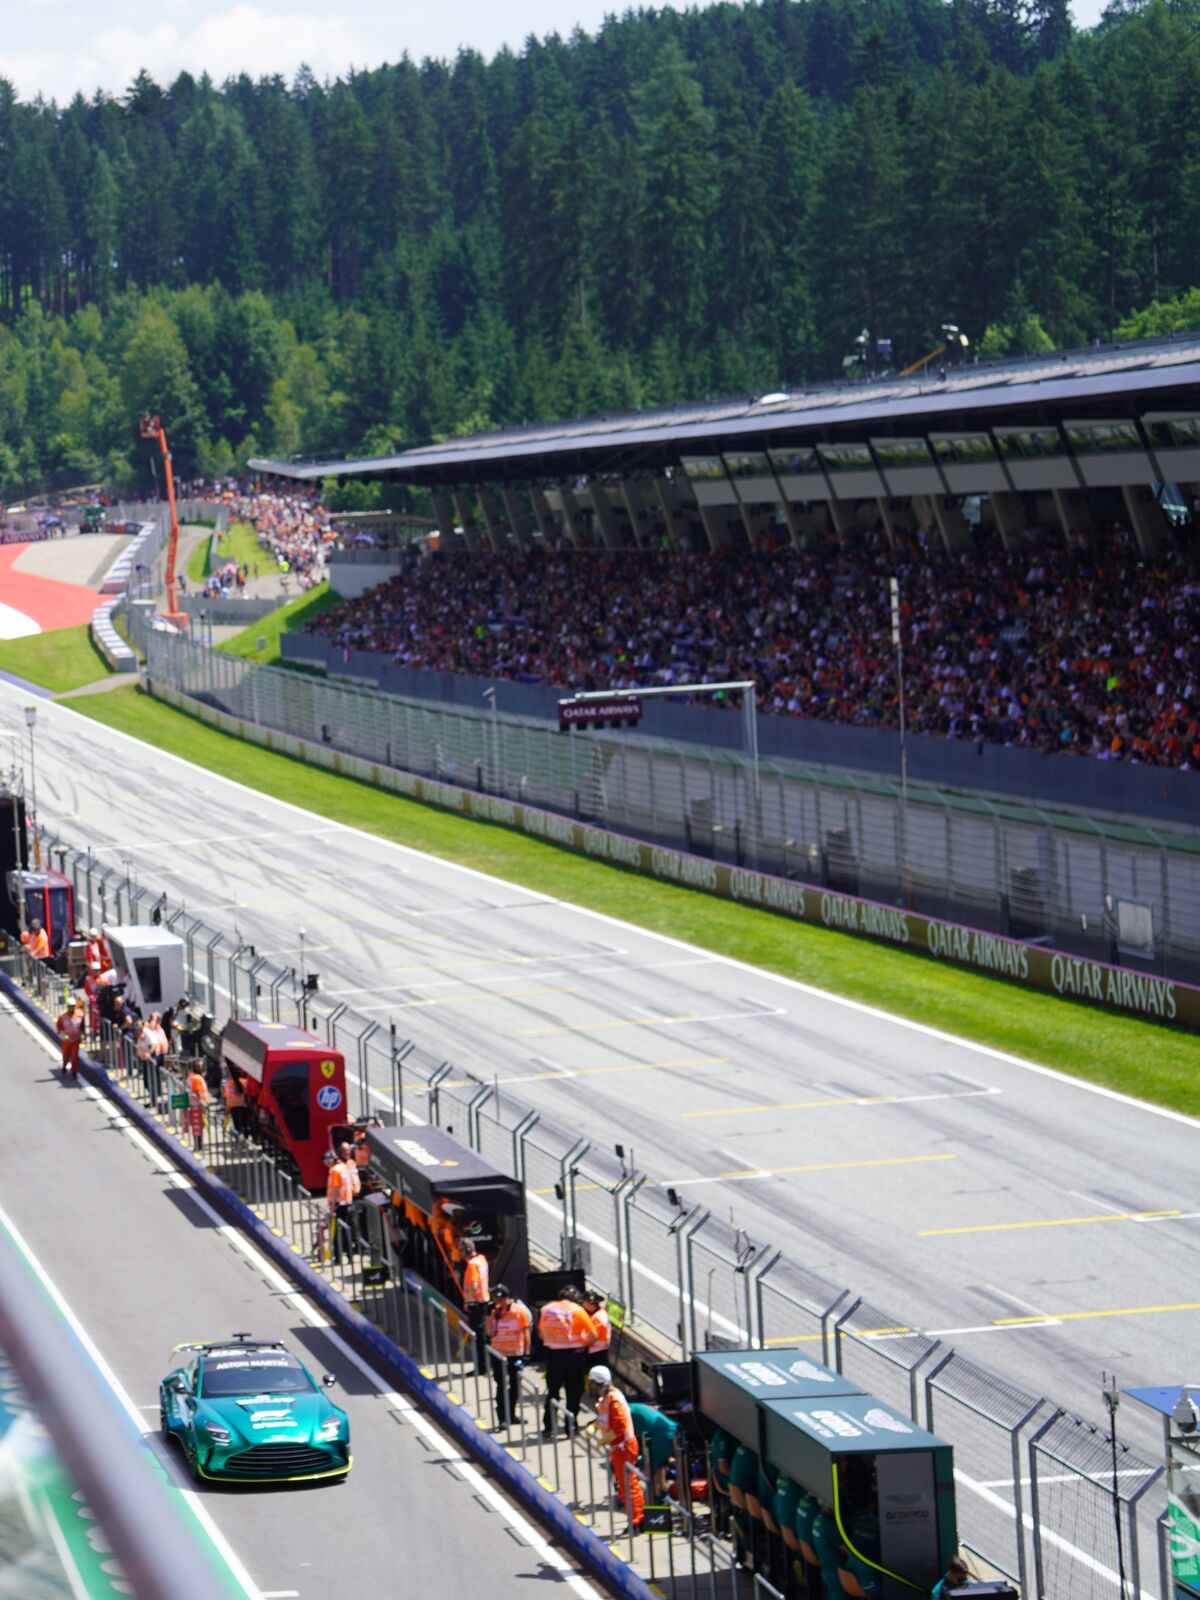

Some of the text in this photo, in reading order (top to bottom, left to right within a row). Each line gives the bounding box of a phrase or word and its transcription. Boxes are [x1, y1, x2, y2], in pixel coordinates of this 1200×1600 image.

[563, 705, 639, 718] QATAR AIRWAYS
[730, 868, 762, 902] QATAR
[821, 893, 909, 943] QATAR AIRWAYS
[927, 920, 1028, 979] QATAR AIRWAYS
[1051, 955, 1176, 1019] QATAR AIRWAYS
[320, 1086, 339, 1109] hp
[216, 1359, 289, 1370] ASTON MARTIN
